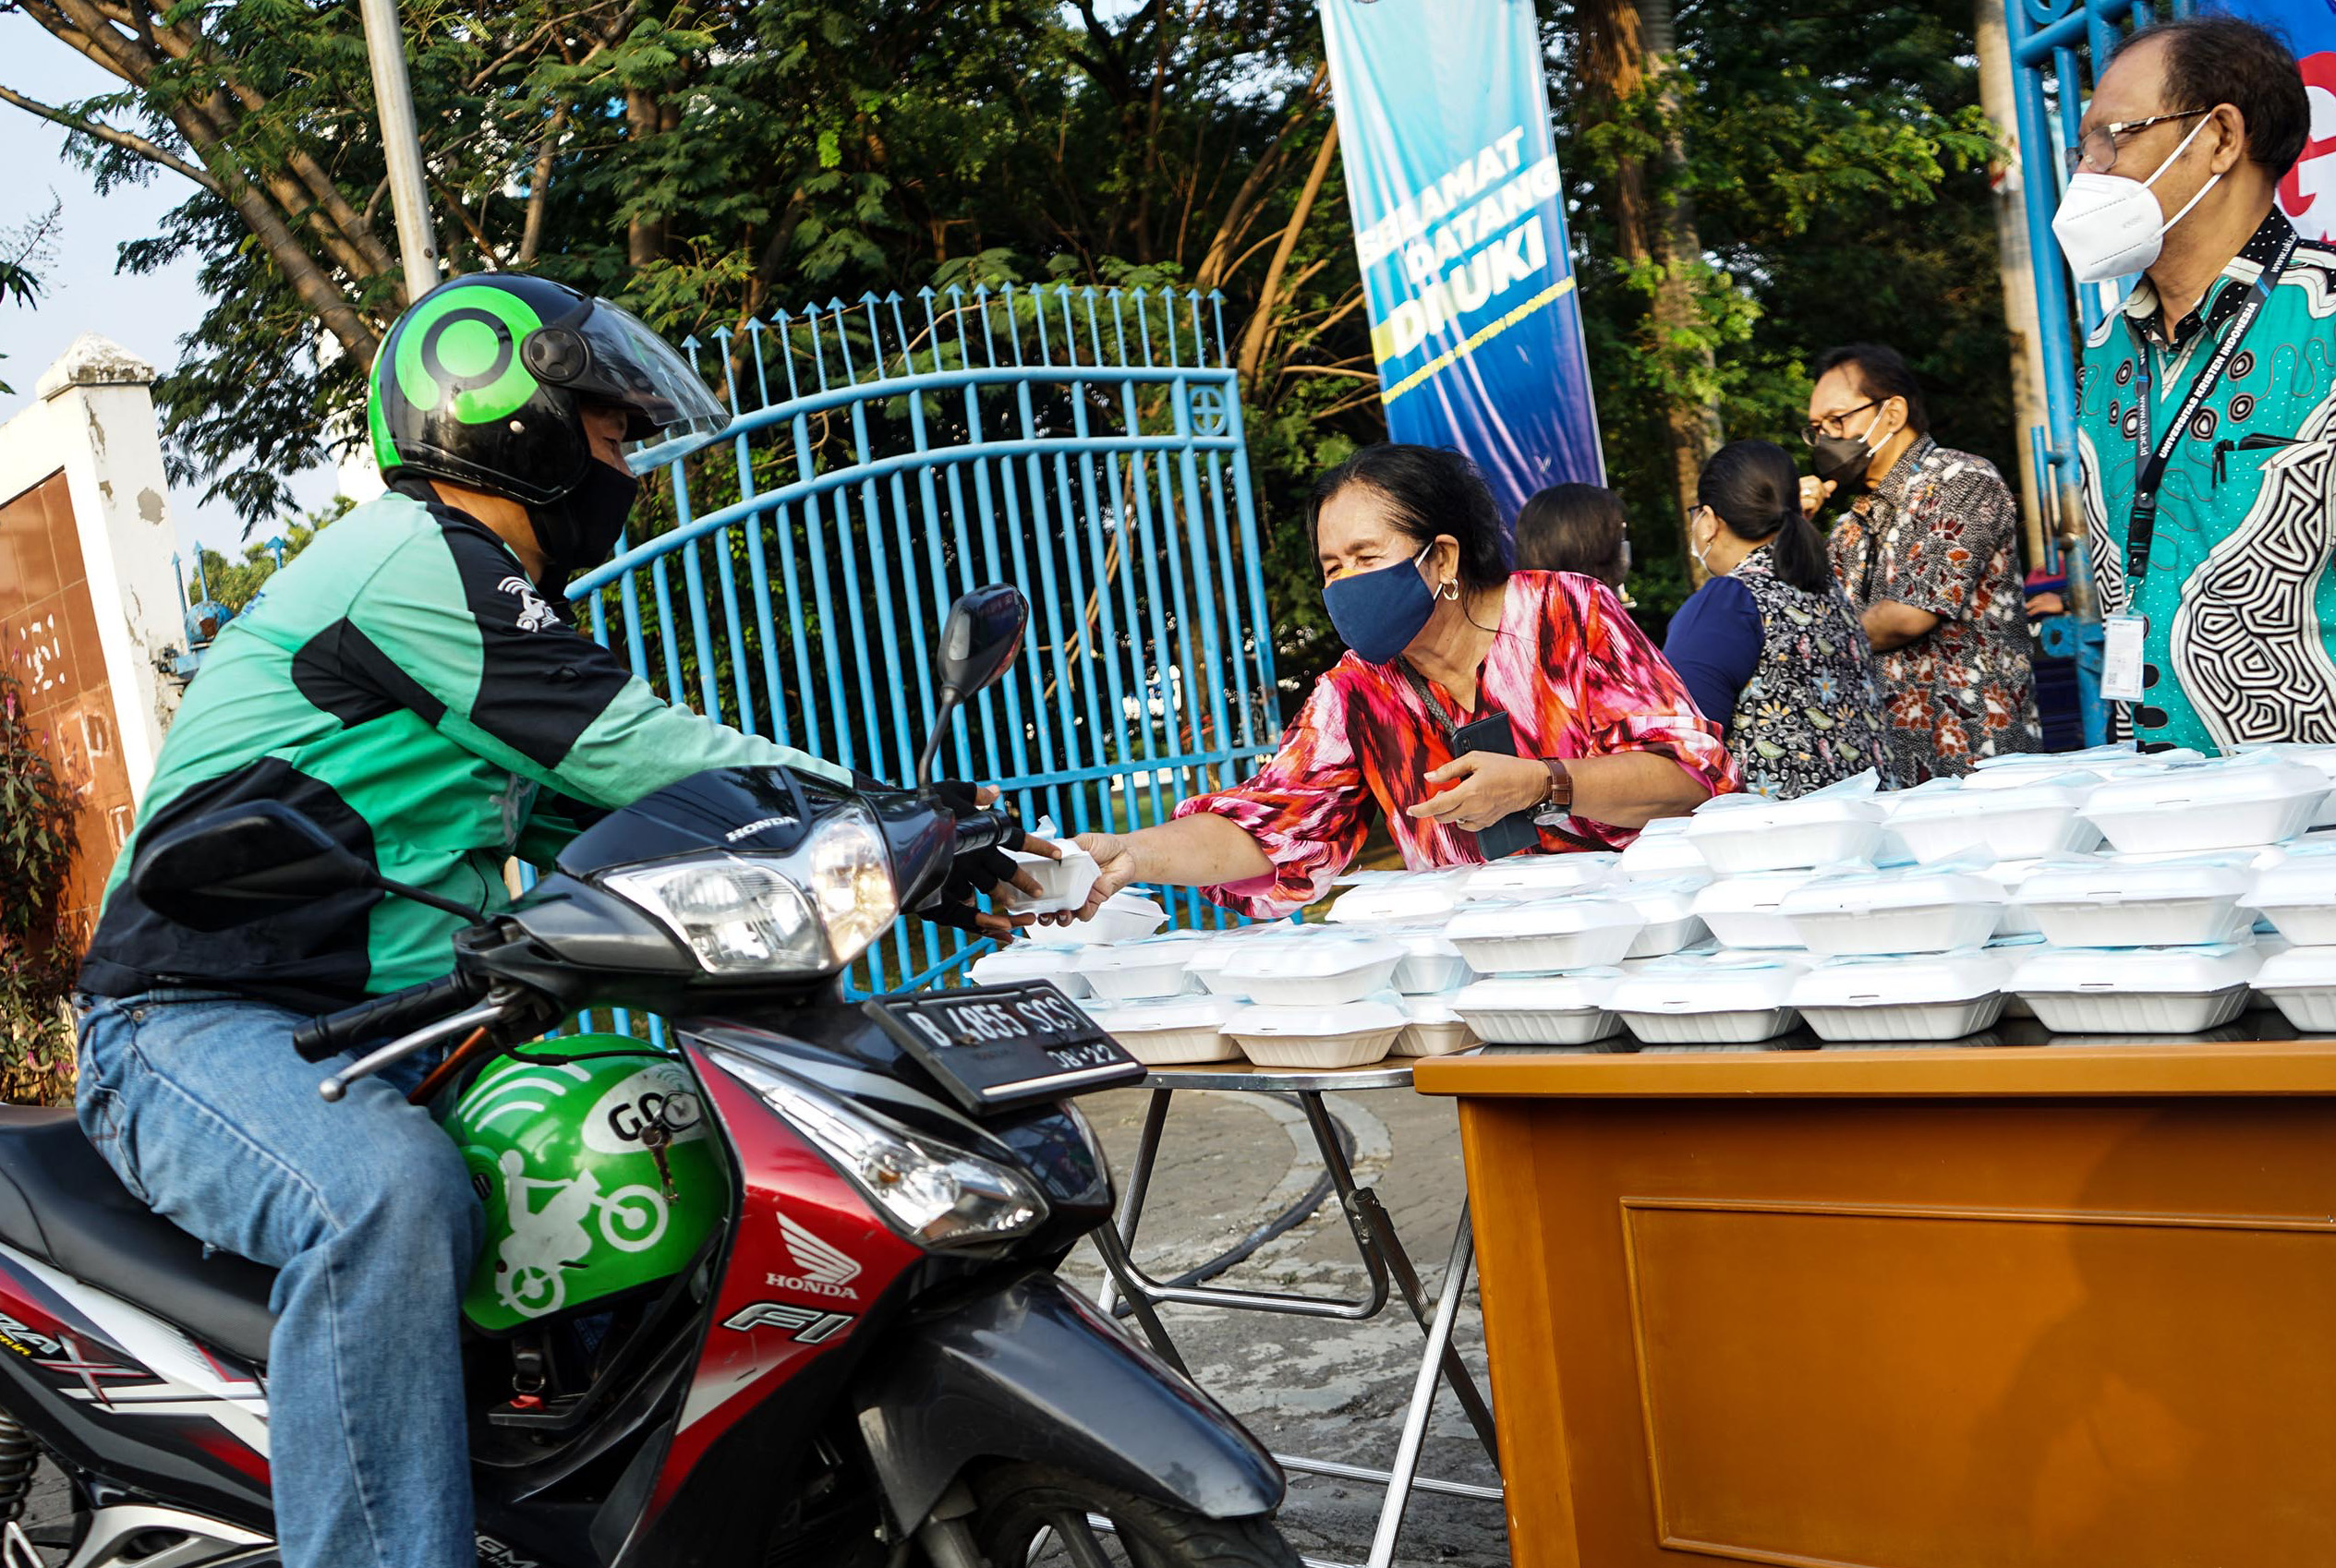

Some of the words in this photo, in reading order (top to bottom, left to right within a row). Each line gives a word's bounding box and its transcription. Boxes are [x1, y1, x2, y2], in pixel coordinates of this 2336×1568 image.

[1359, 125, 1524, 259] SELAMAT
[1407, 155, 1562, 284] DATANG
[1389, 282, 1446, 358] DI
[1449, 214, 1548, 314] UKI
[2159, 397, 2199, 459] UNIVERSITAS
[2194, 355, 2226, 398] KRISTEN
[2220, 302, 2258, 356] INDONESIA
[725, 816, 800, 842] HONDA
[907, 1011, 953, 1047] B
[946, 1004, 1027, 1043] 4855
[719, 1301, 855, 1345] FI
[766, 1272, 859, 1299] HONDA
